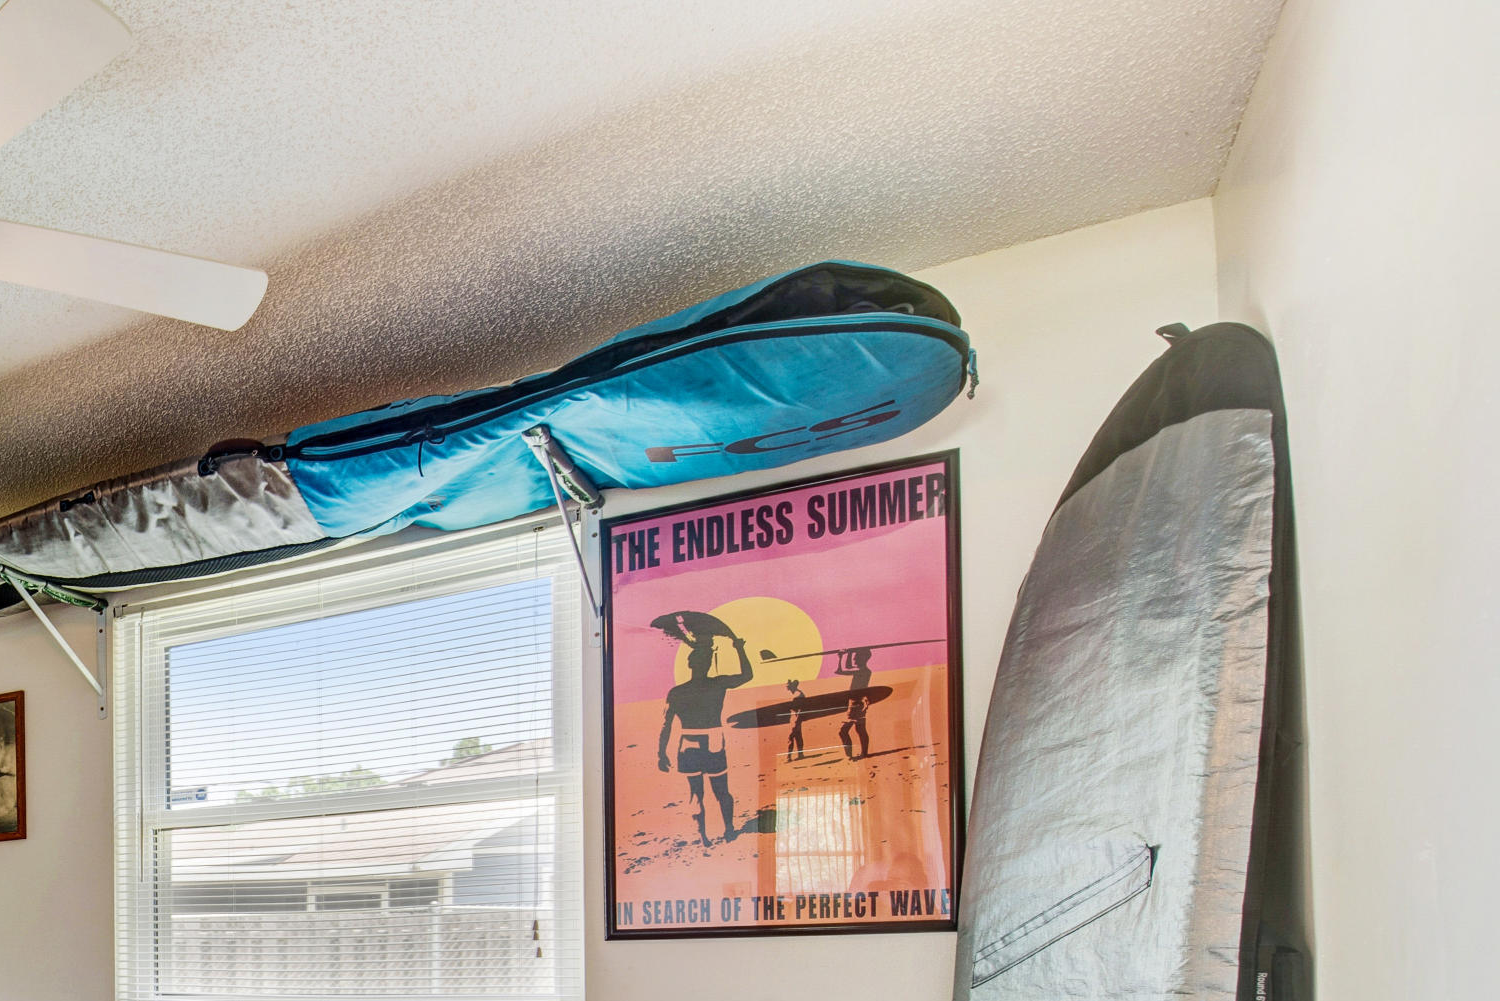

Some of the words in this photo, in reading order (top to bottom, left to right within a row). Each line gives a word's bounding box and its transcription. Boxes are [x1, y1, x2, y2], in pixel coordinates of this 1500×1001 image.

[645, 400, 900, 462] FCS
[611, 526, 660, 574] THE
[673, 501, 794, 563] ENDLESS
[807, 472, 946, 539] SUMMER
[617, 901, 633, 926] IN
[643, 898, 711, 925] SEARCH
[721, 897, 742, 922] OF
[751, 895, 786, 920] THE
[796, 891, 879, 919] PERFECT
[890, 888, 950, 917] WAVE
[1256, 972, 1268, 995] Round
